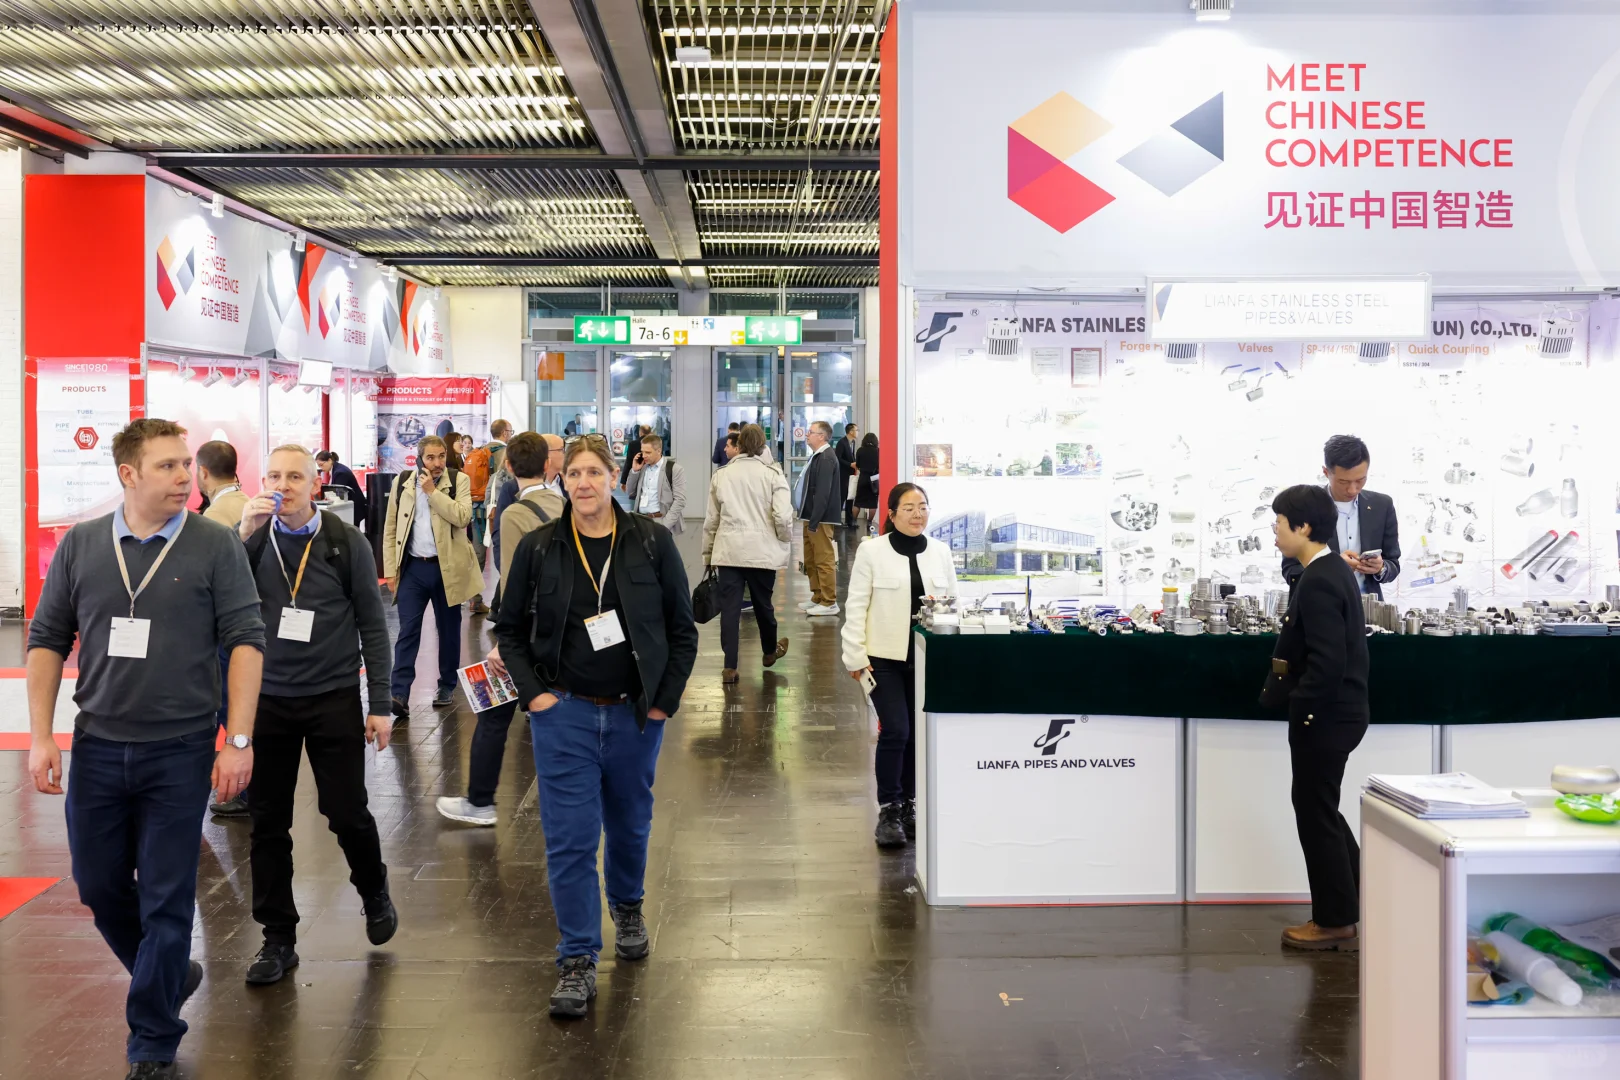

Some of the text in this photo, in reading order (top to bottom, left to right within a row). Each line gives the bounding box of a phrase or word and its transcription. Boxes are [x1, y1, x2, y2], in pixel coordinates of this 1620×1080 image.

[1267, 63, 1367, 92] MEET
[1265, 101, 1426, 130] CHINESE
[1265, 138, 1514, 168] COMPETENCE
[1264, 190, 1514, 229] 见证中国智造
[206, 234, 217, 251] EET
[201, 270, 239, 294] COMPETENCE
[1204, 293, 1389, 308] LIANFA STAINLESS STEEL
[1245, 310, 1353, 325] PIPES&VALVES
[1432, 320, 1465, 339] UN)
[1120, 341, 1151, 353] Forge
[1237, 342, 1274, 353] Valves
[1408, 344, 1439, 355] Quick
[1442, 344, 1490, 356] Coupling
[85, 364, 108, 372] 1980
[977, 758, 1136, 770] LIANFA PIPES AND VALVES
